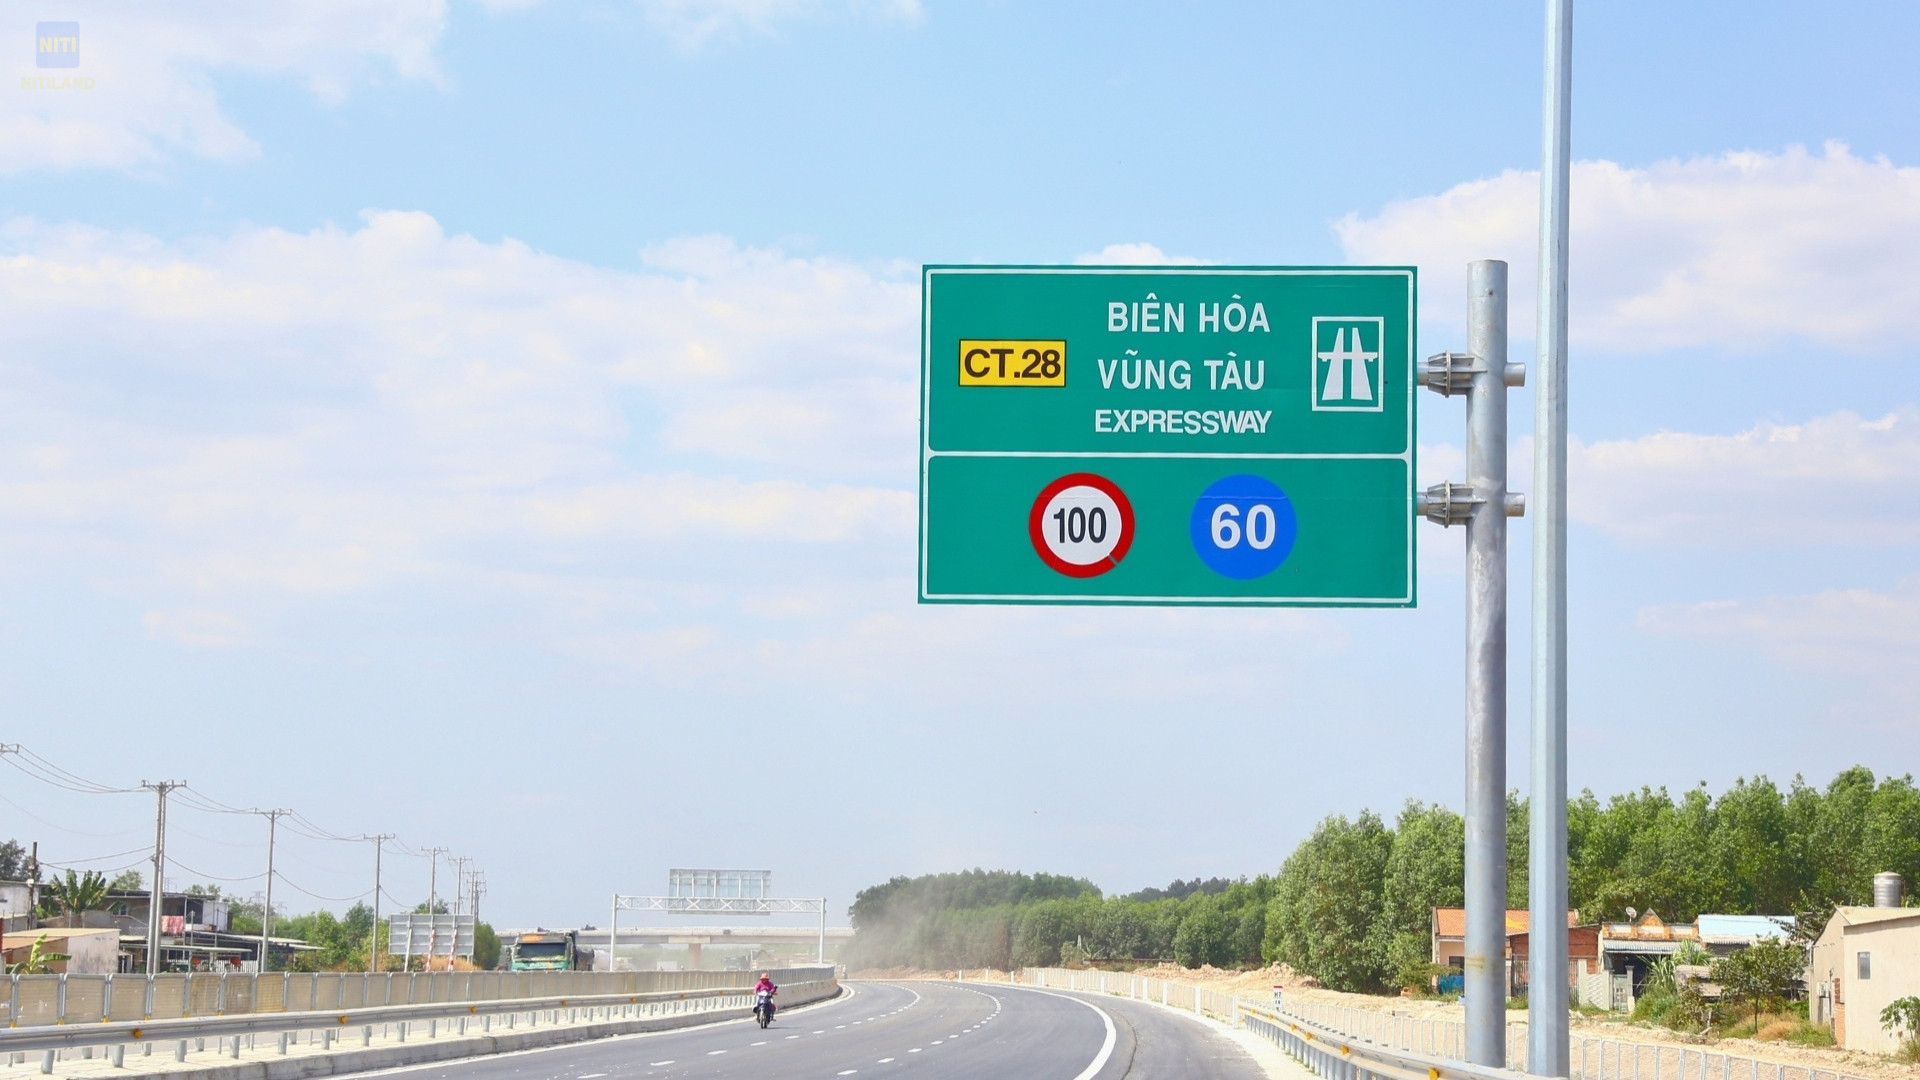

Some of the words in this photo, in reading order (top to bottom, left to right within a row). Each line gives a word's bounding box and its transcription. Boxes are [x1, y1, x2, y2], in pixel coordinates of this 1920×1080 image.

[1107, 293, 1185, 333] BIÊN
[1199, 294, 1271, 333] HÒA
[964, 348, 1062, 379] CT.28
[1097, 349, 1192, 391] VŨNG
[1203, 351, 1266, 391] TÀU
[1095, 409, 1273, 434] EXPRESSWAY
[1053, 507, 1108, 544] 100
[1210, 503, 1277, 550] 60
